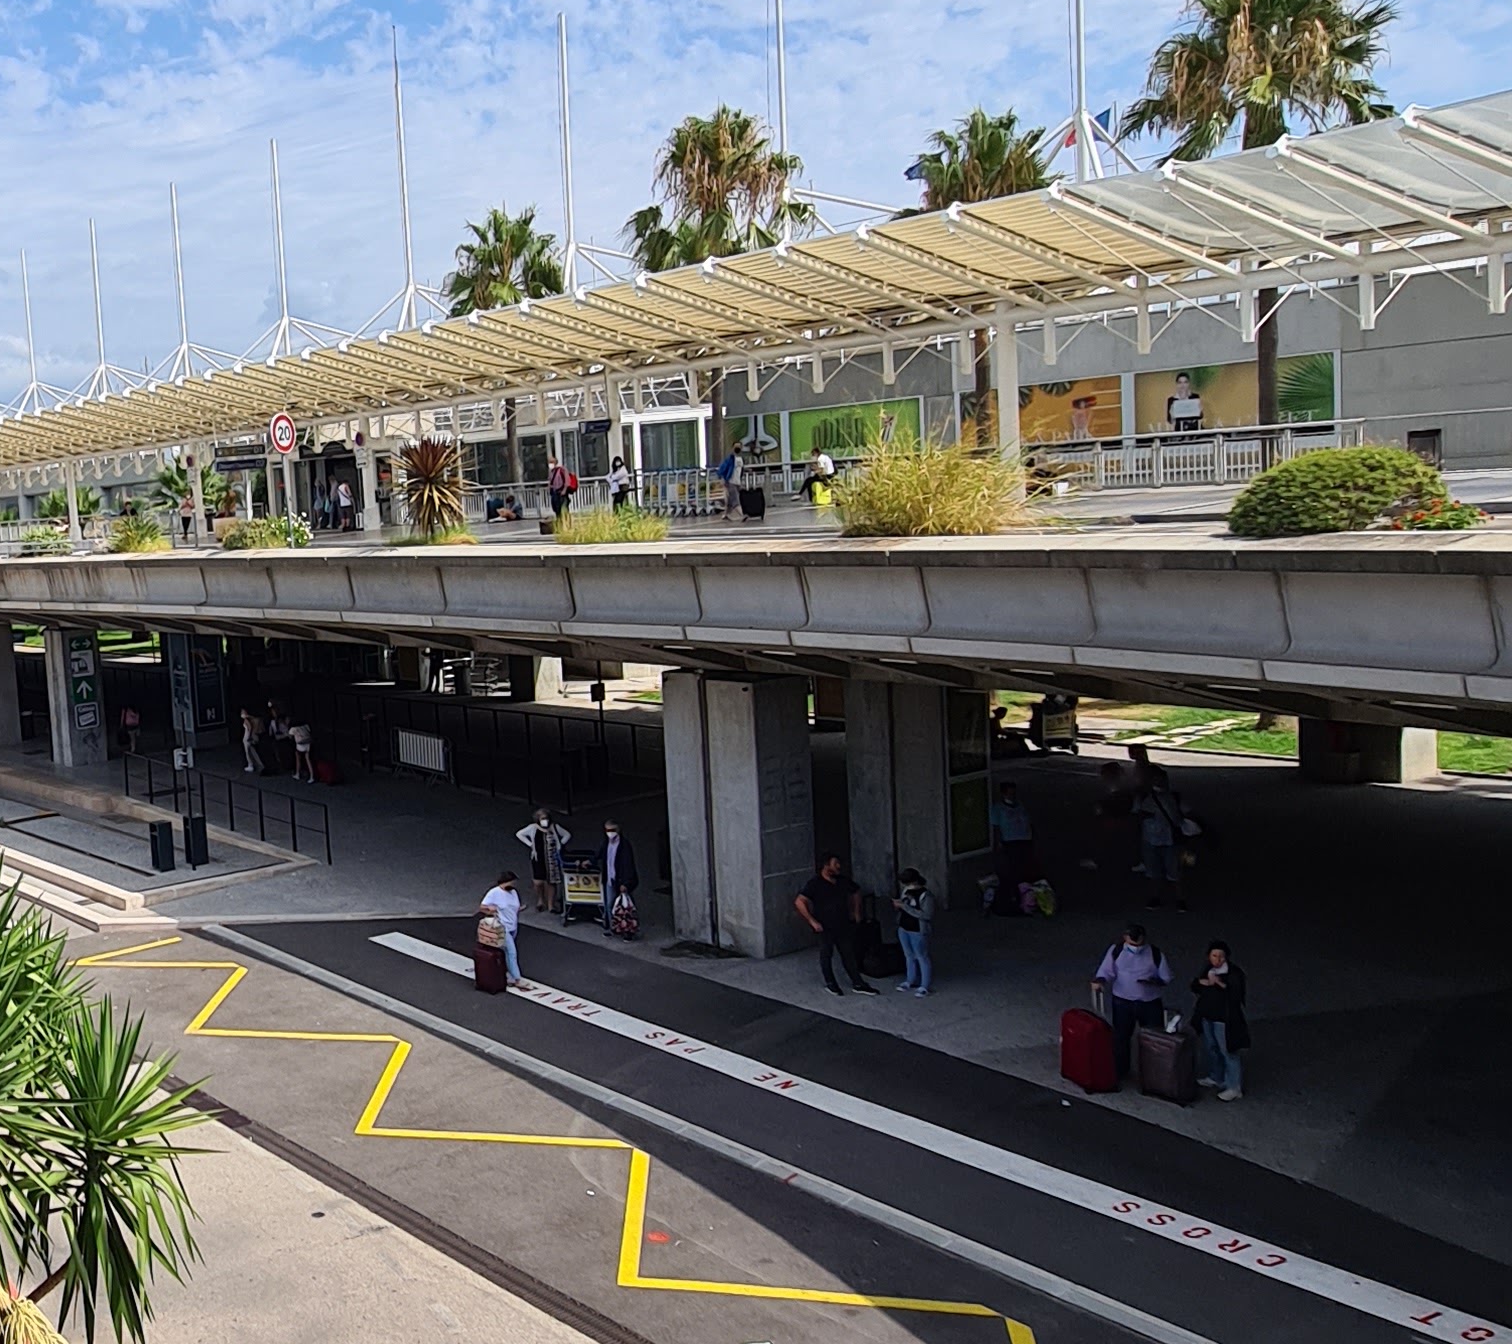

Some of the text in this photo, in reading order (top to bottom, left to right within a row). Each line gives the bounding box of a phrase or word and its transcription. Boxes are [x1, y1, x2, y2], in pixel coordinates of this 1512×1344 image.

[277, 425, 291, 441] 20
[644, 1031, 706, 1054] PAS
[752, 1072, 800, 1090] NE
[1112, 1200, 1287, 1267] CROSS
